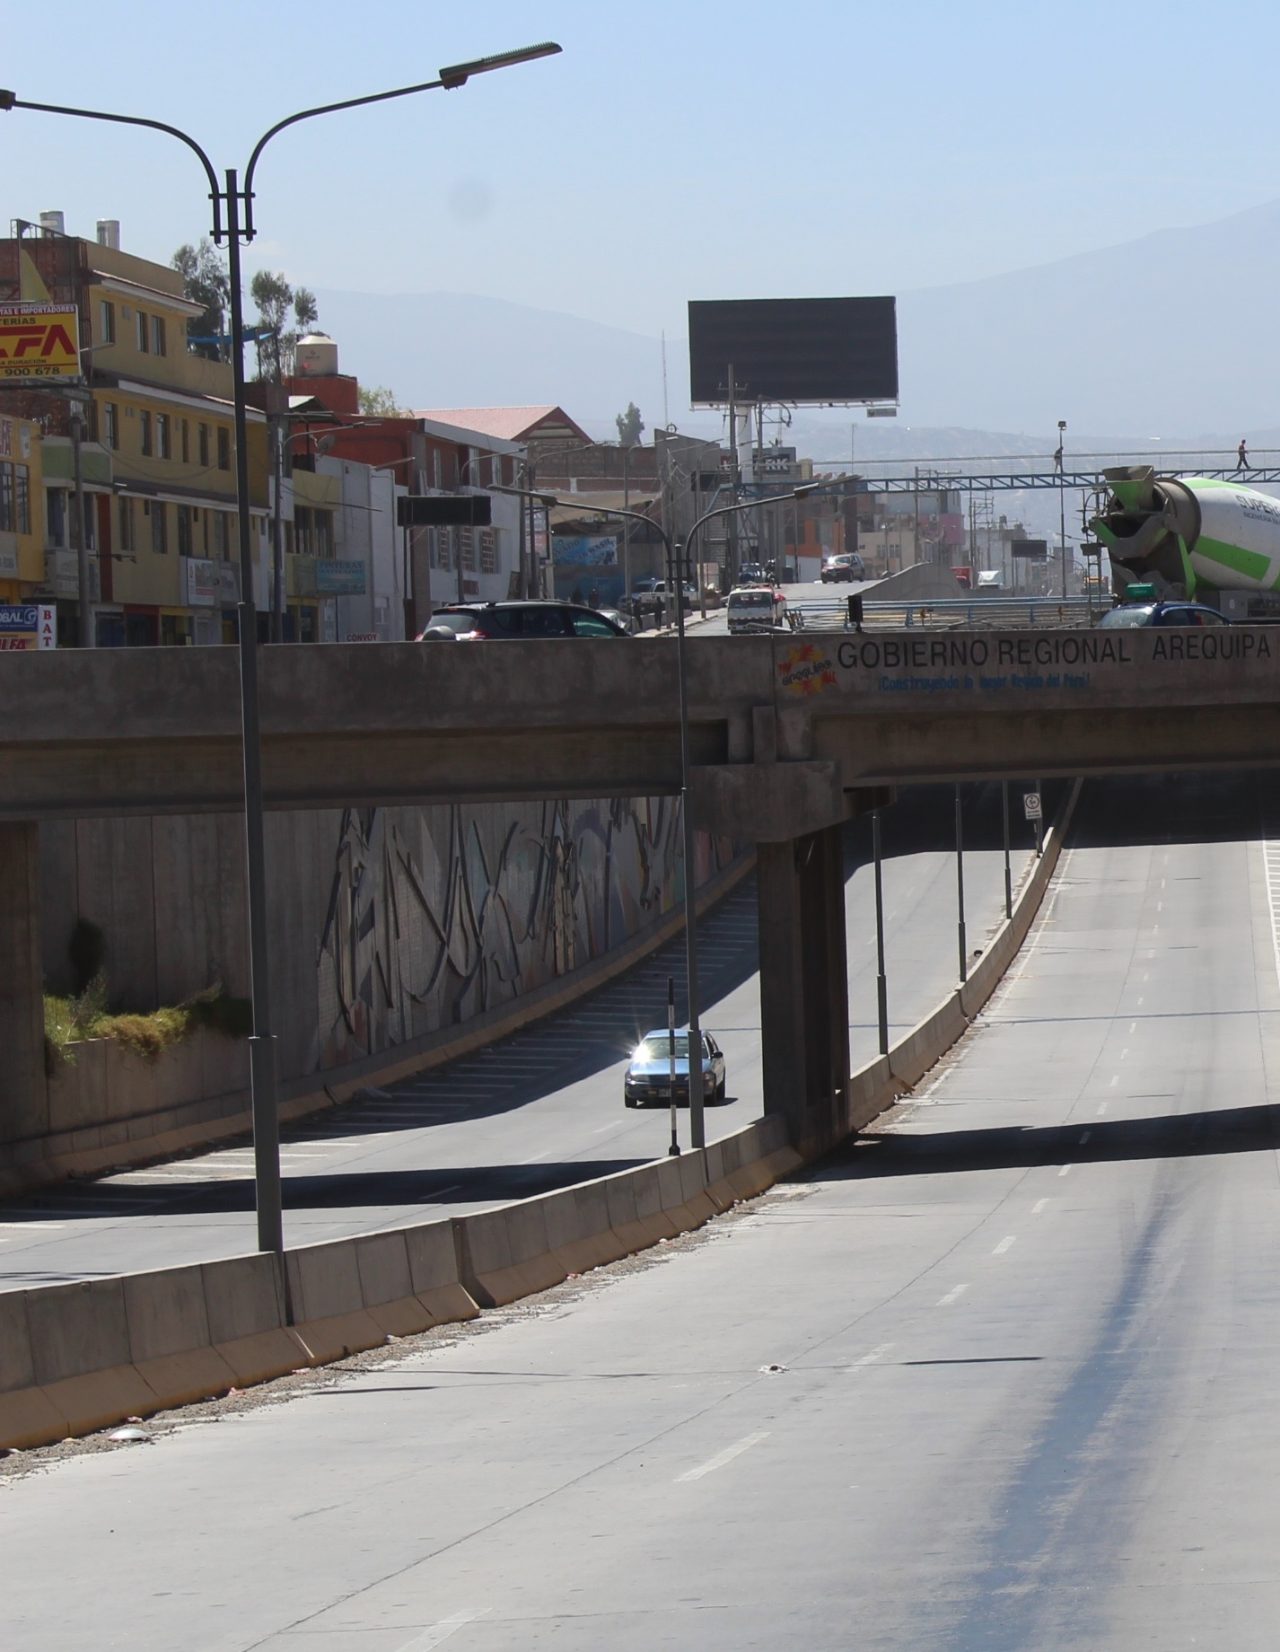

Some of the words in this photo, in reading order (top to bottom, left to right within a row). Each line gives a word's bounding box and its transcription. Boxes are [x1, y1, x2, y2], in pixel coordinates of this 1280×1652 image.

[20, 305, 75, 314] IMPORTADORES
[4, 367, 30, 376] 900
[35, 366, 60, 375] 678
[837, 639, 988, 669] GOBIERNO
[998, 637, 1131, 665] REGIONAL
[1152, 634, 1271, 660] AREQUIPA
